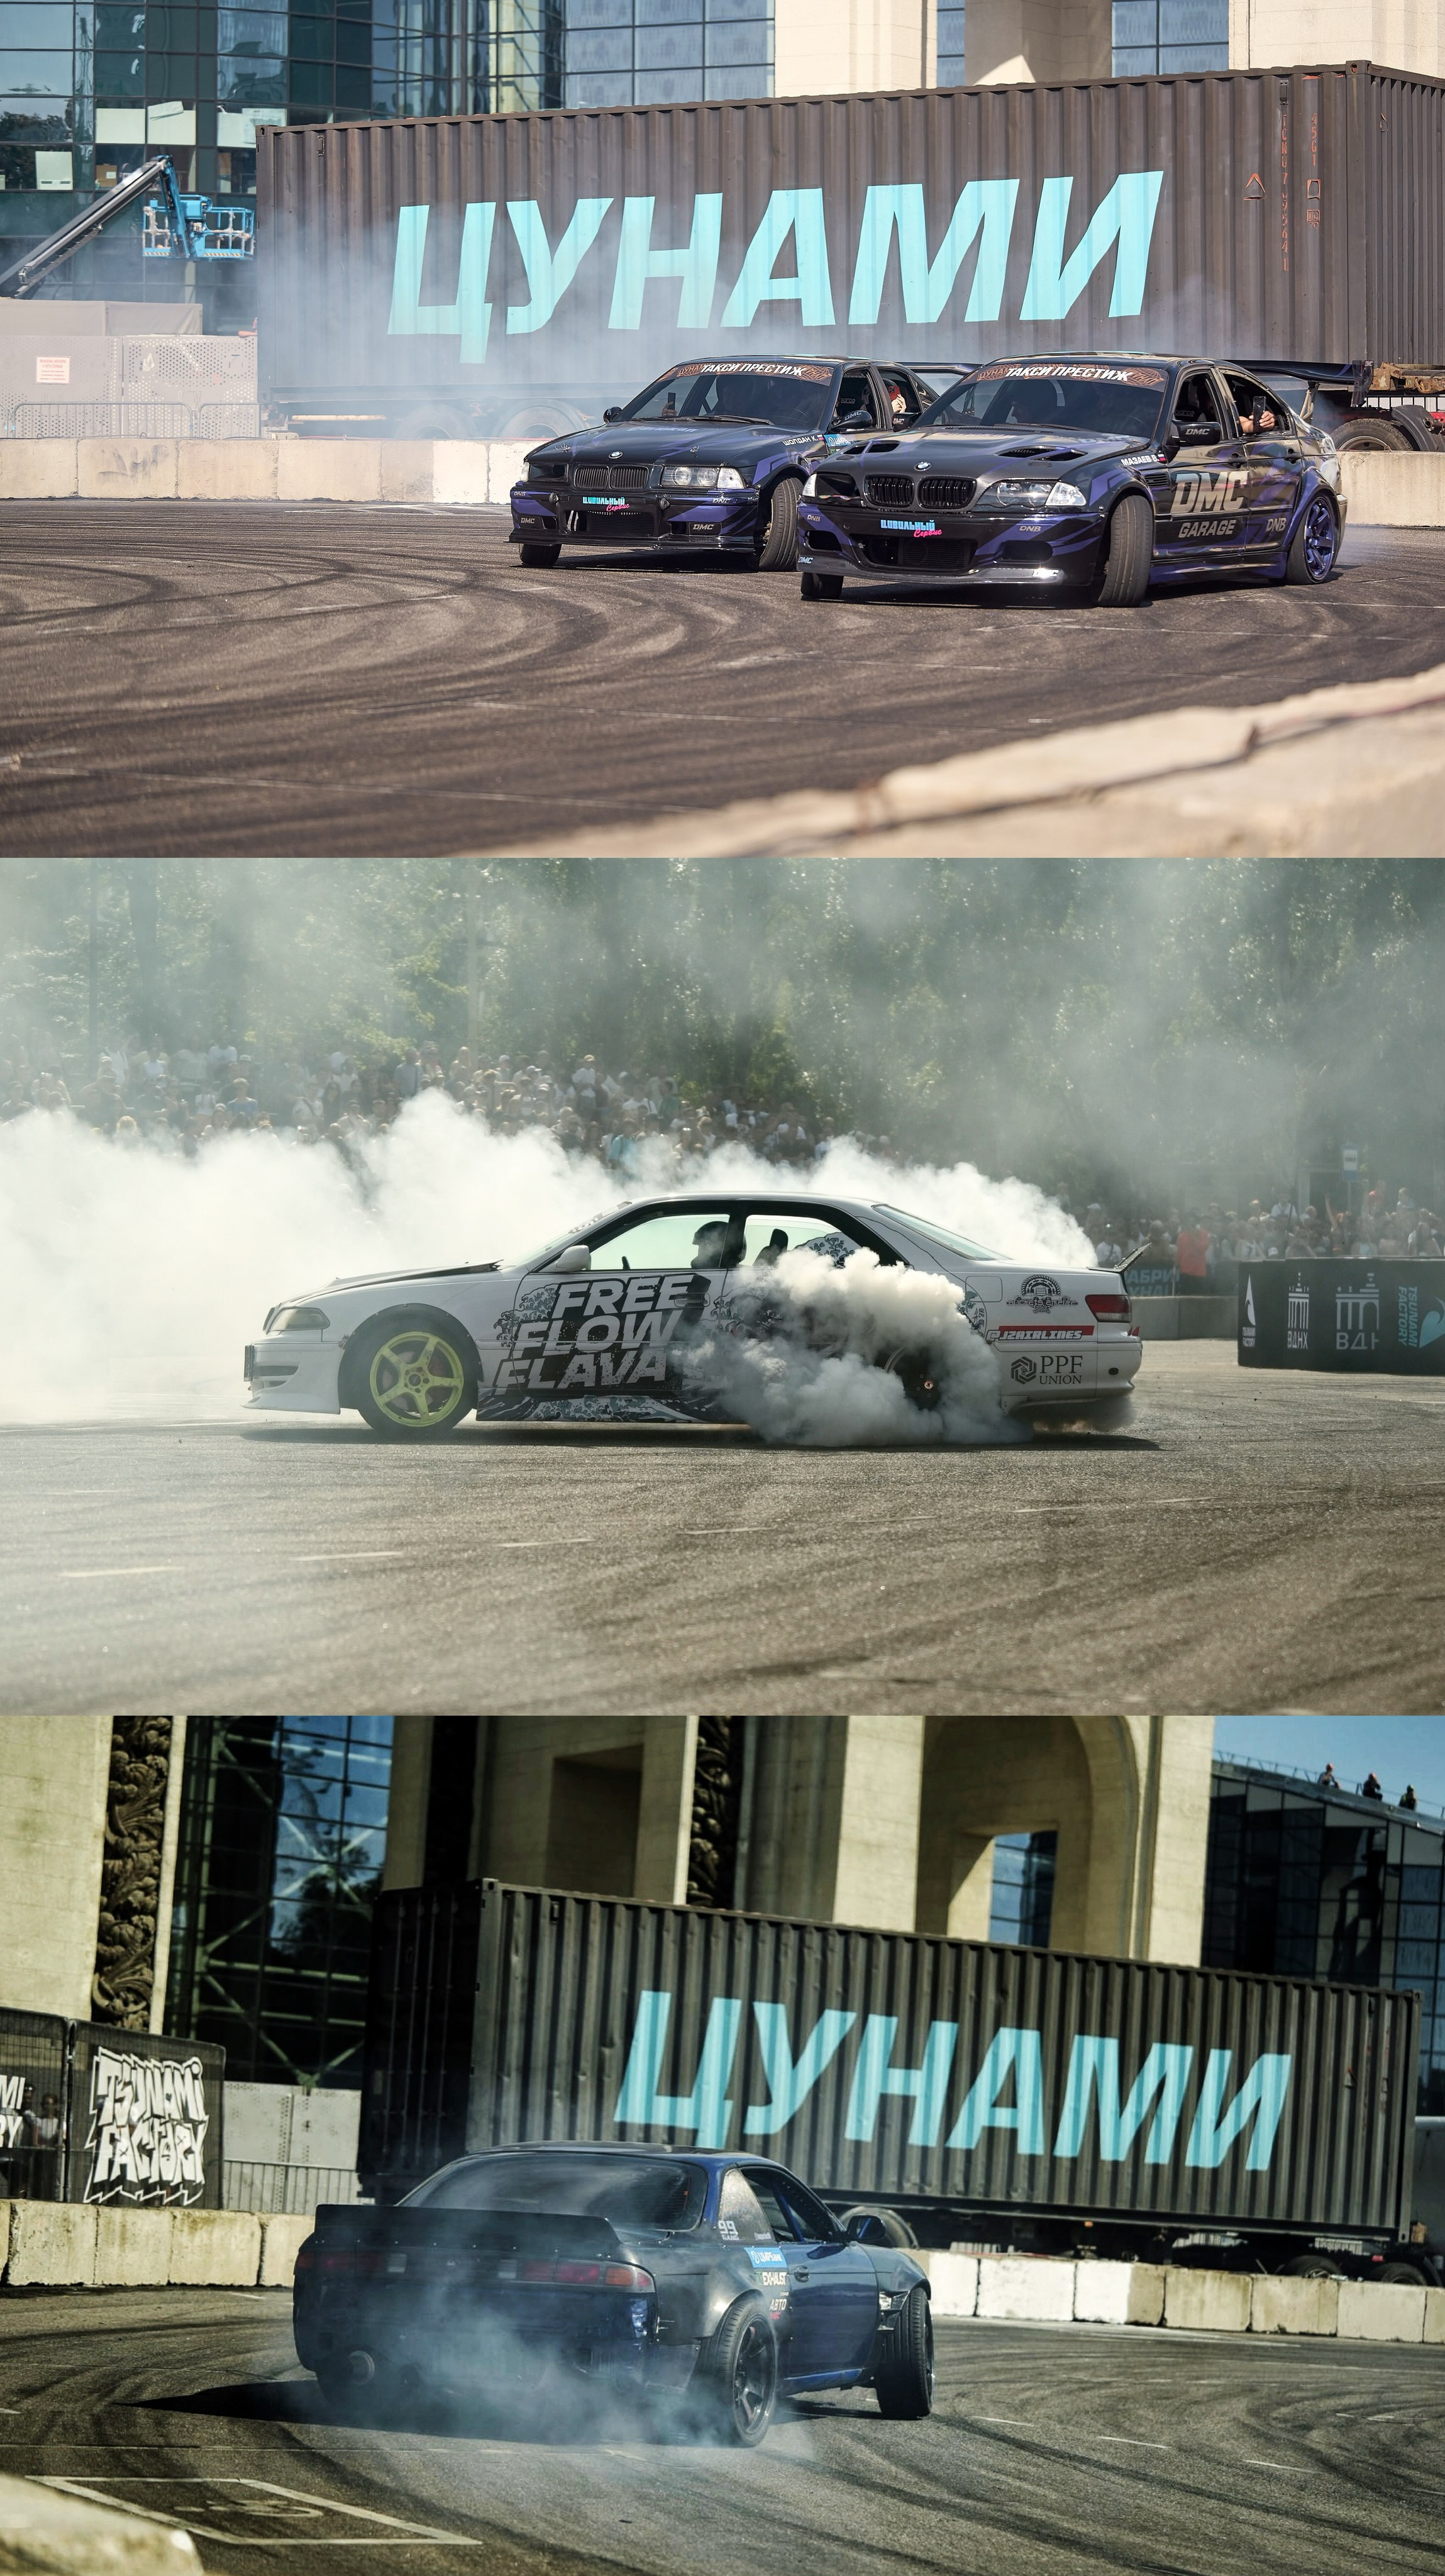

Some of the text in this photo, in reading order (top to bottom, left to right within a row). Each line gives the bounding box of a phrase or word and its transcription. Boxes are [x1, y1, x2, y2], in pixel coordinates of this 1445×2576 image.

[387, 171, 1163, 363] ЦУНАМИ
[700, 364, 807, 376] ТАКСИ ПРЕСТИЖ
[1005, 367, 1133, 382] ТАКСИ ПРЕСТИЖ
[844, 411, 861, 421] DMC
[1121, 455, 1152, 466] МАЗАЕВ
[1170, 471, 1249, 514] DMC
[606, 503, 630, 511] Сервис
[1178, 520, 1236, 538] GARAGE
[1266, 517, 1287, 533] DNB
[914, 529, 942, 538] Сервис
[551, 1274, 694, 1319] FREE
[1398, 1286, 1408, 1347] FACTORY
[1409, 1286, 1419, 1347] TSUNAMI
[507, 1309, 684, 1359] FLOW
[986, 1330, 1083, 1341] @JZAIRLINES
[1287, 1330, 1308, 1350] ВДНХ
[1040, 1355, 1083, 1374] PPF
[494, 1351, 667, 1395] FLAVA
[1039, 1375, 1082, 1384] UNION
[612, 1990, 1291, 2170] ЦУНАМИ
[718, 2221, 738, 2235] 99
[762, 2272, 787, 2285] EXHAUST
[769, 2299, 787, 2311] АВТО
